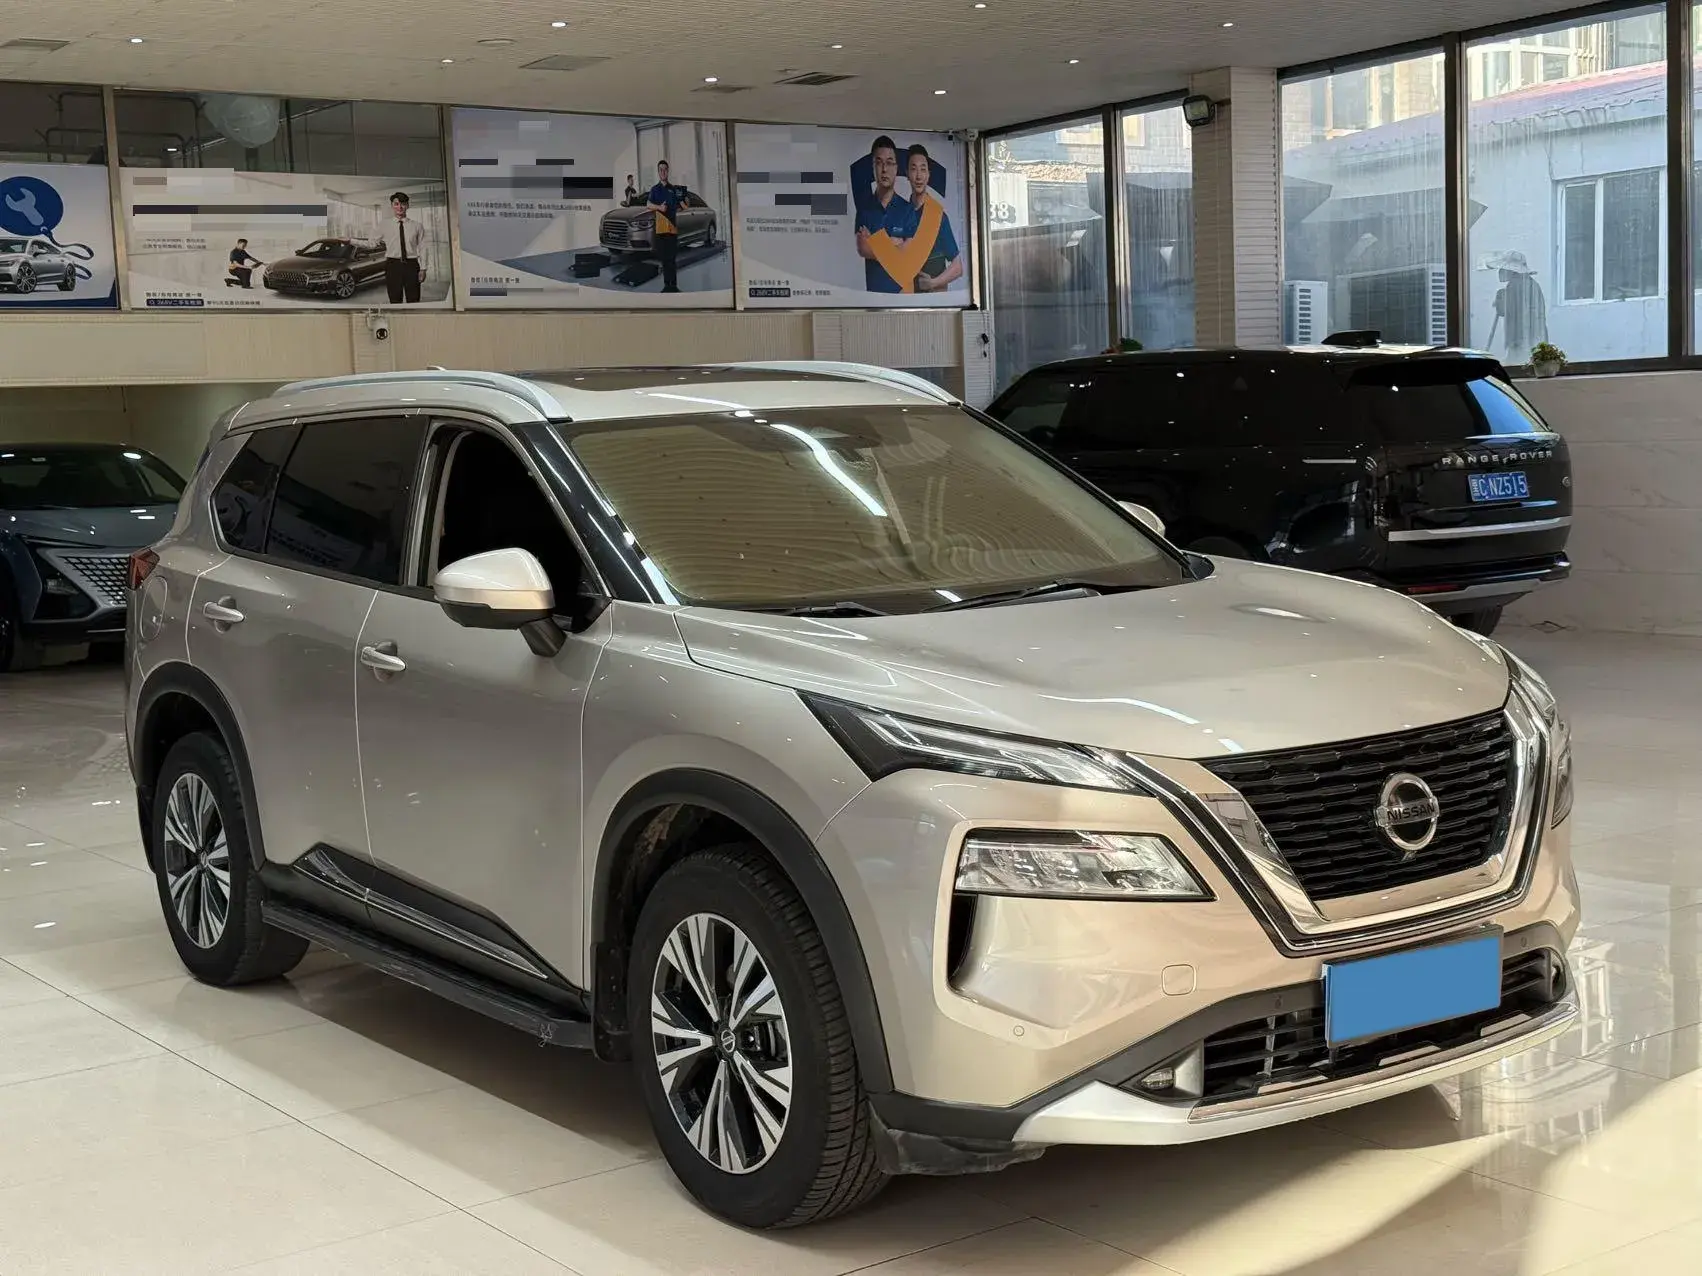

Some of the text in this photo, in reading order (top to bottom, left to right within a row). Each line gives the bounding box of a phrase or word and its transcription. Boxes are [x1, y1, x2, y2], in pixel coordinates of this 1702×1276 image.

[1441, 450, 1553, 465] RANGE ROVER
[1387, 802, 1435, 820] NISSAN
